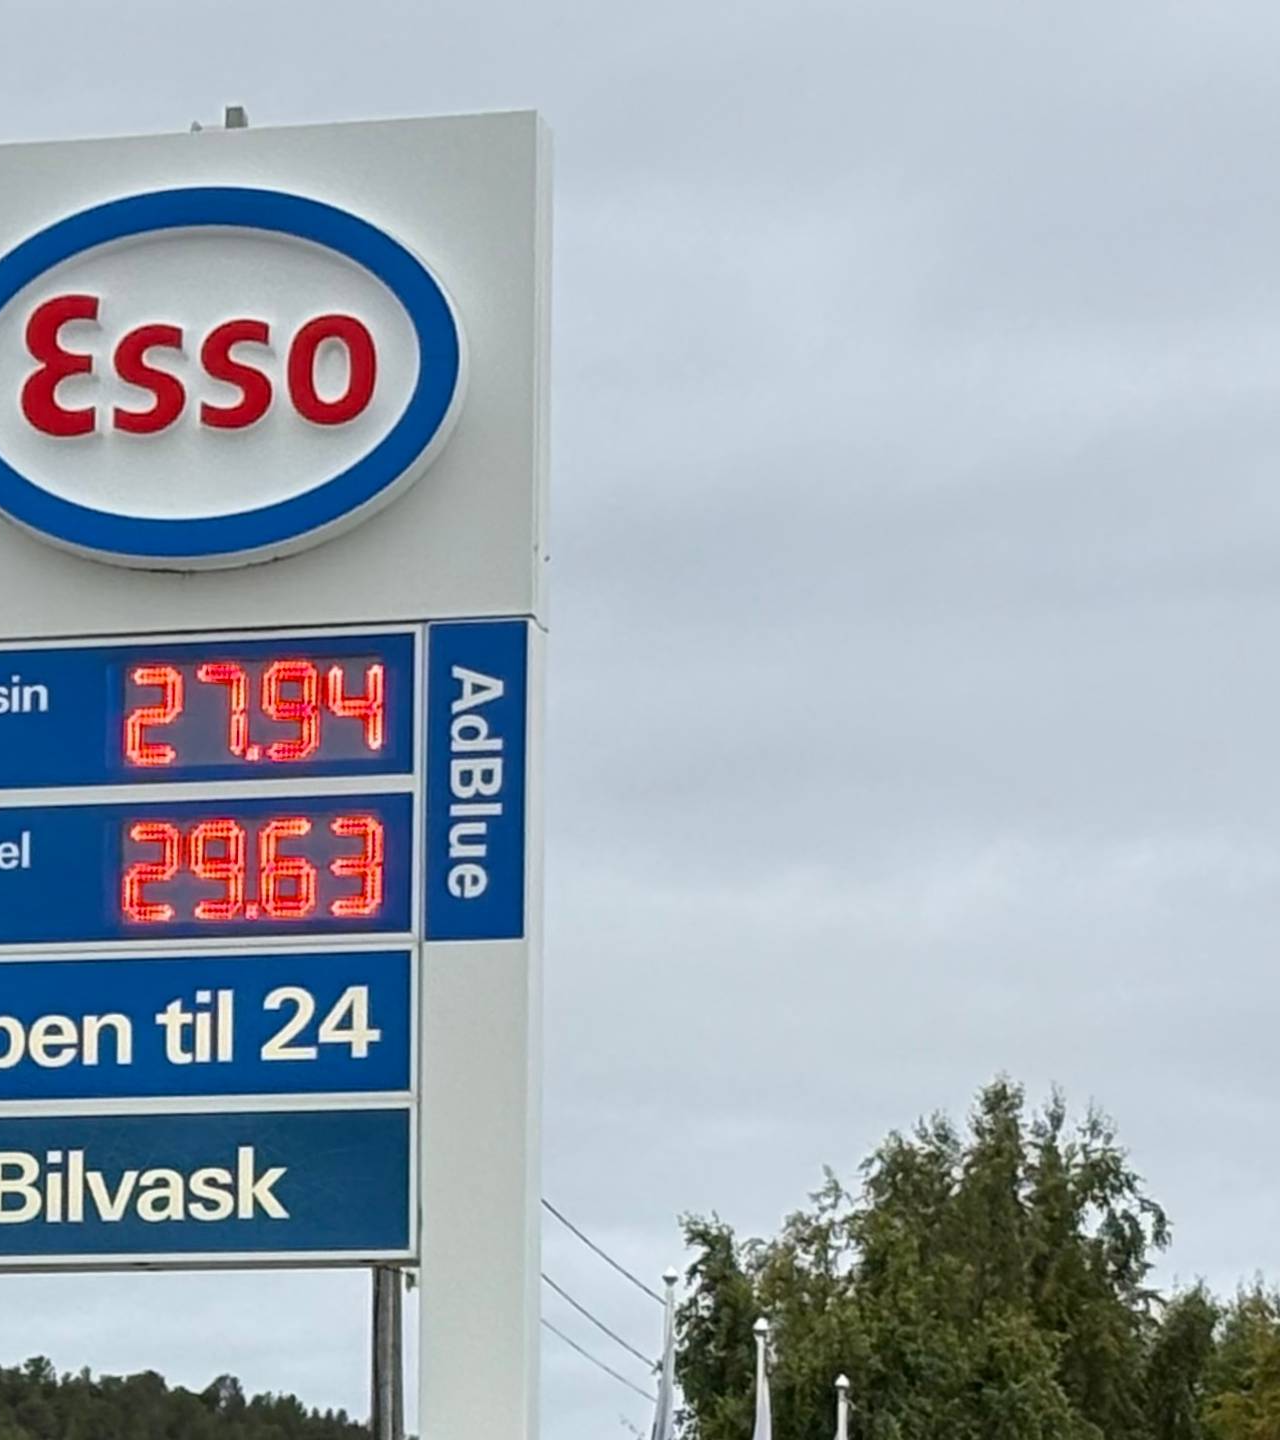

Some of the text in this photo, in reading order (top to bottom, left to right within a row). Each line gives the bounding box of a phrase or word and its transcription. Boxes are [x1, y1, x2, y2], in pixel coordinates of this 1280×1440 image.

[19, 293, 377, 437] Esso
[447, 665, 505, 899] AdBlue
[155, 988, 233, 1065] til
[260, 984, 380, 1061] 24
